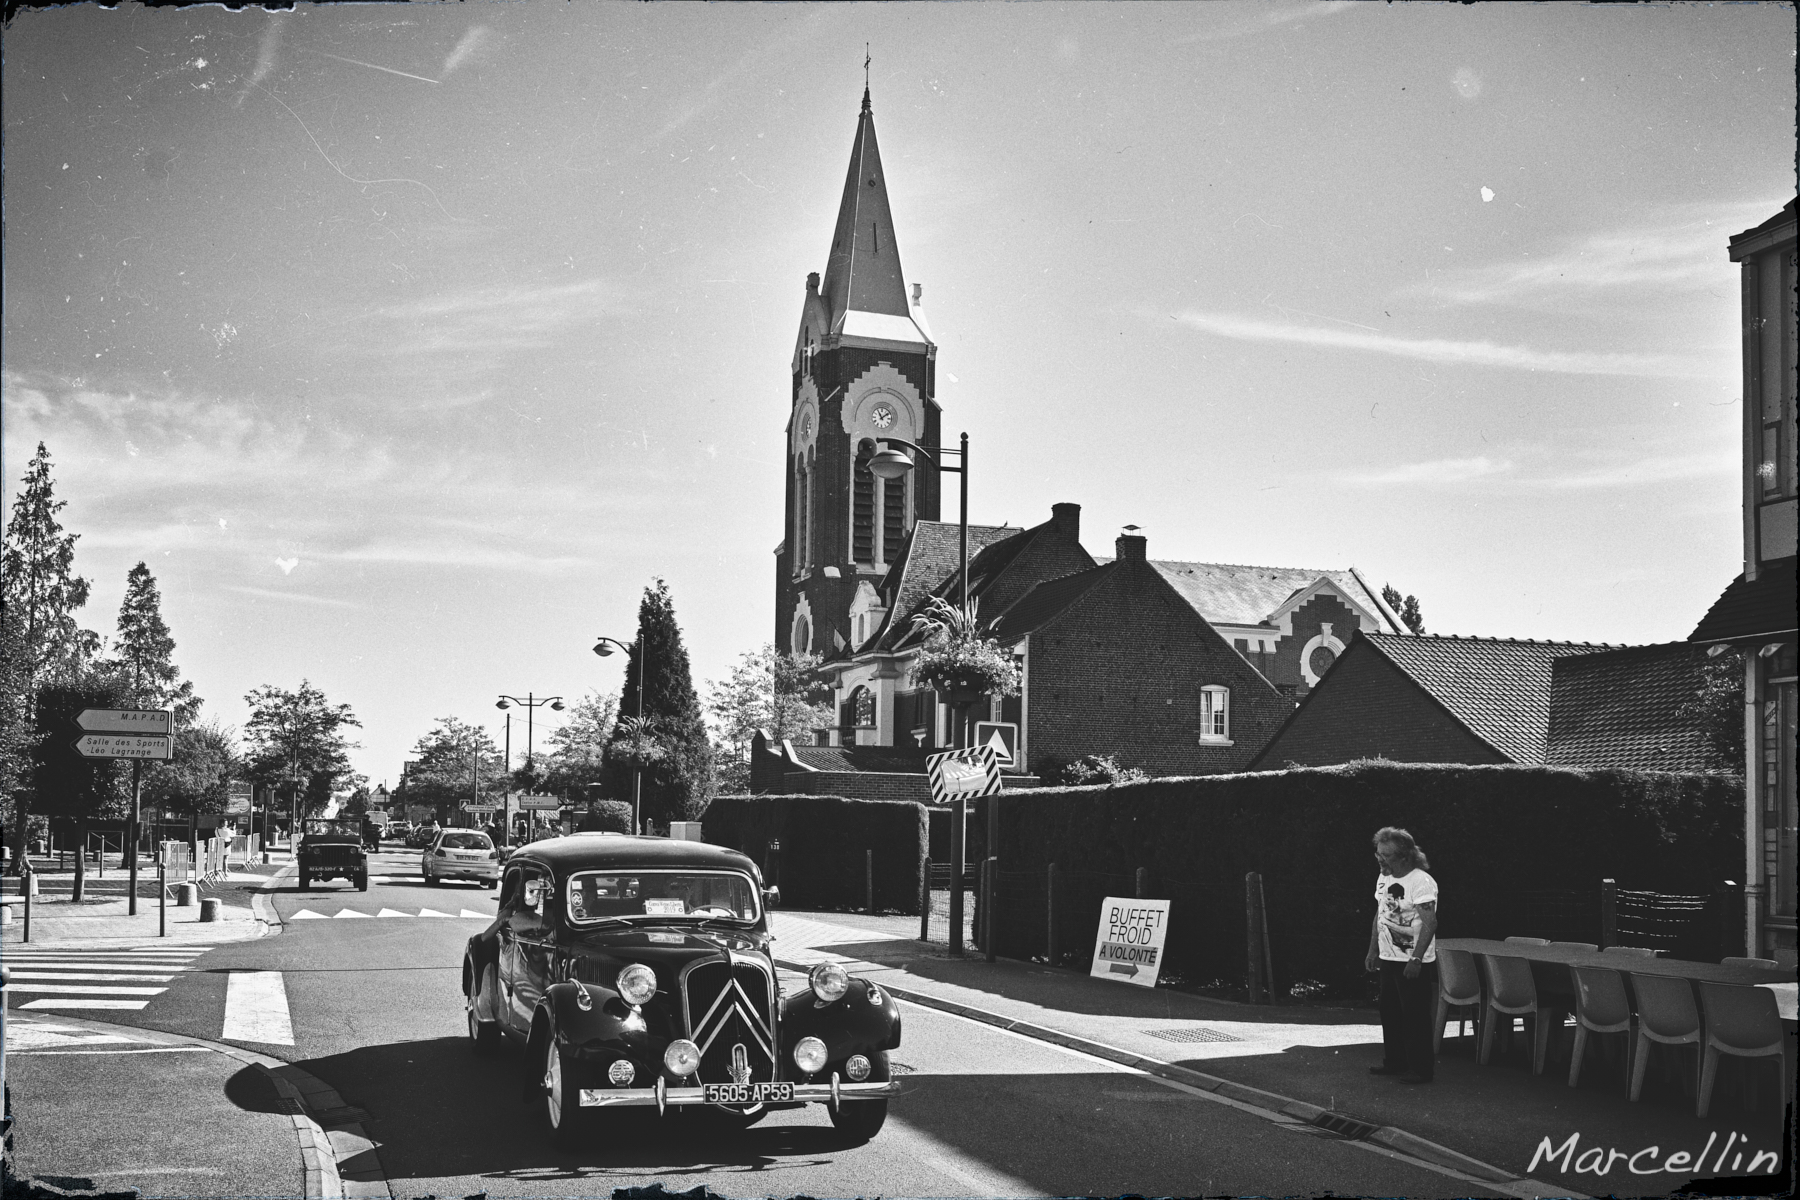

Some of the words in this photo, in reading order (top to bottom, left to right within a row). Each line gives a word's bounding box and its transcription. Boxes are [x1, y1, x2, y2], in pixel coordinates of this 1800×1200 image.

[86, 737, 110, 746] Salle
[115, 738, 131, 746] des
[136, 739, 165, 749] Sports
[111, 747, 152, 758] Lagrange
[1109, 906, 1165, 928] BUFFET
[1108, 924, 1152, 945] FROID
[1109, 945, 1158, 964] VOLONTÉ
